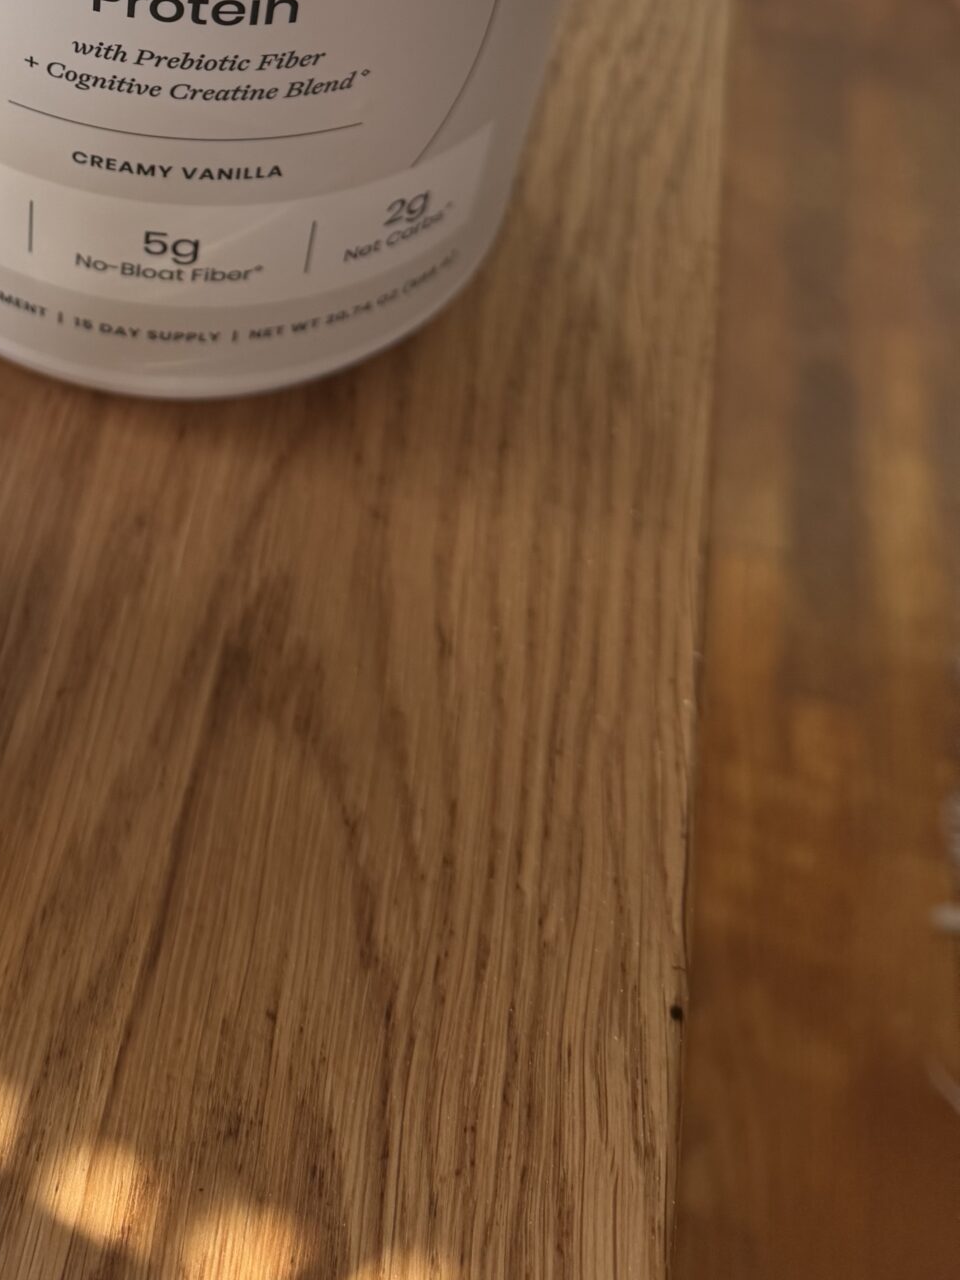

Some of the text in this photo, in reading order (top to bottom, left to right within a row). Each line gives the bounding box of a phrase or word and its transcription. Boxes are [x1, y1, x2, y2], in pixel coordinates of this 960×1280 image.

[71, 40, 327, 72] with Prebiotic Fiber
[46, 61, 162, 98] Cognitive
[169, 82, 279, 102] Creatine
[71, 151, 284, 181] CREAMY VANILLA
[383, 190, 431, 227] 2g
[143, 230, 200, 265] 5g
[343, 239, 382, 263] Net
[75, 252, 184, 282] No-Bloat
[98, 322, 140, 339] DAY
[147, 328, 221, 344] SUPPLY
[248, 324, 285, 341] NET
